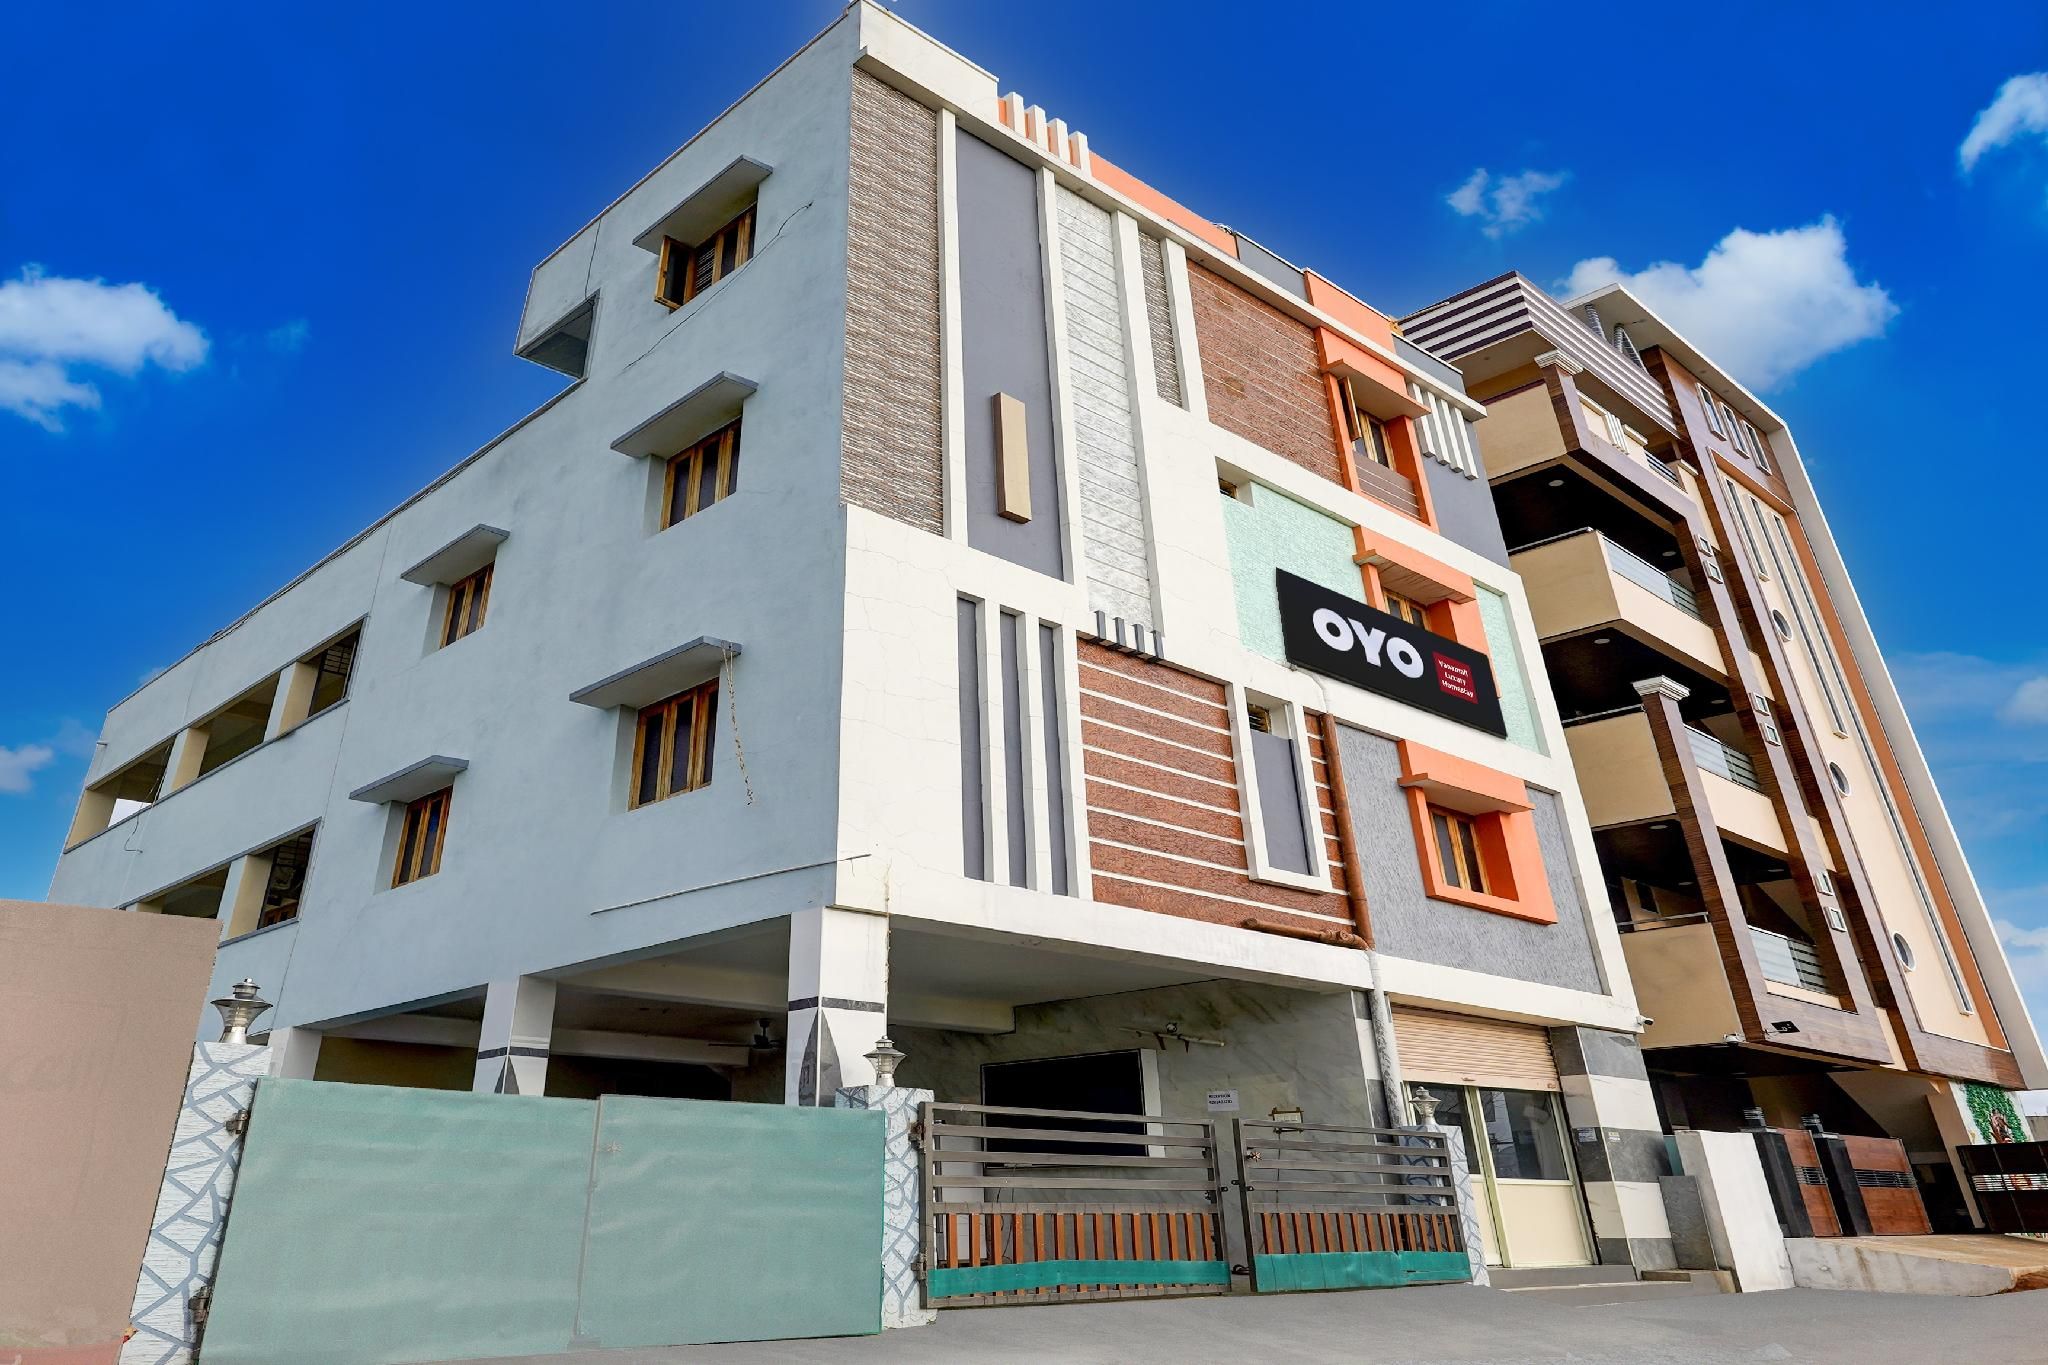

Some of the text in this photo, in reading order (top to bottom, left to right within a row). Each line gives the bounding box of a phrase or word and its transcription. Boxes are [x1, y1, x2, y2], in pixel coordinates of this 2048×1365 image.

[1313, 608, 1424, 678] OYO
[1444, 672, 1466, 686] Luxury
[1441, 680, 1474, 697] Homestay
